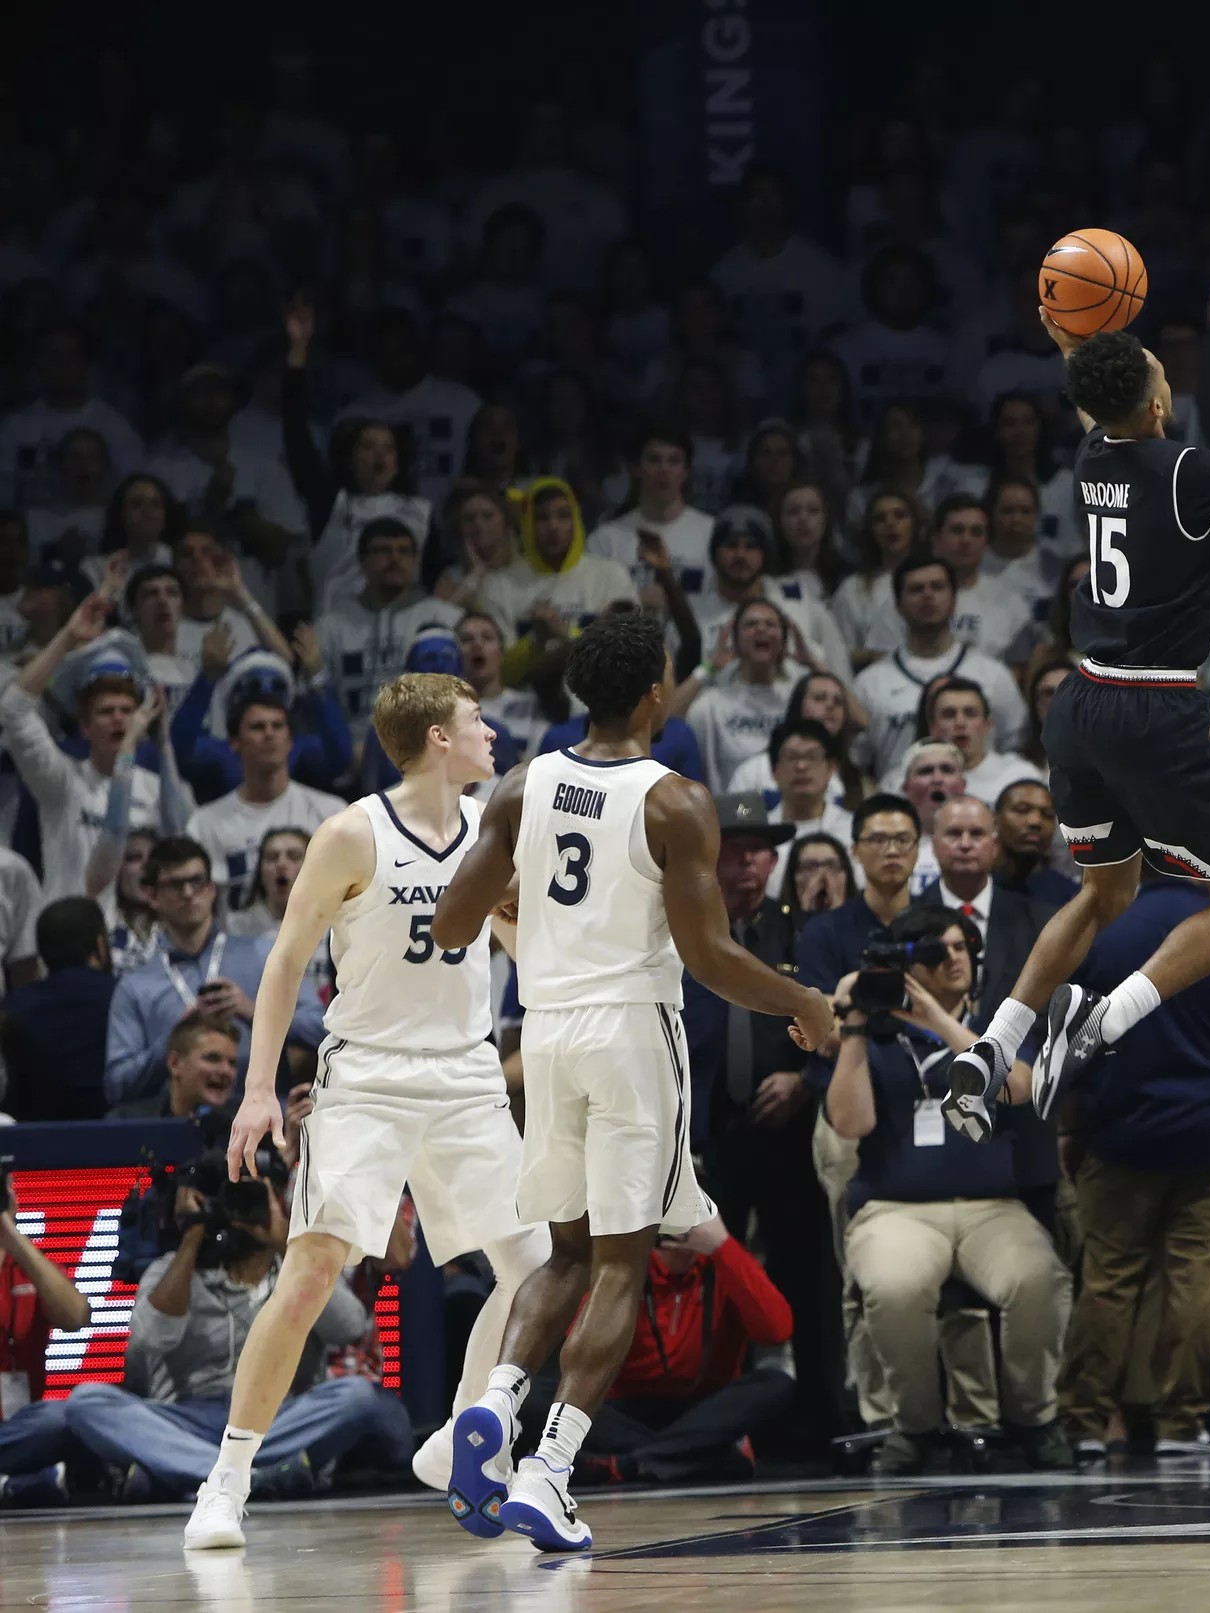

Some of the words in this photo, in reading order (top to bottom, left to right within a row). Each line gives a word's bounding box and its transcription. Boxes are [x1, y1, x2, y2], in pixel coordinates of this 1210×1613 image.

[701, 0, 756, 186] KING
[1043, 277, 1059, 301] X
[1080, 481, 1130, 508] BROOME
[1087, 513, 1131, 608] 15
[552, 782, 607, 820] GOODIN
[547, 832, 594, 907] 3
[388, 885, 449, 905] XAV
